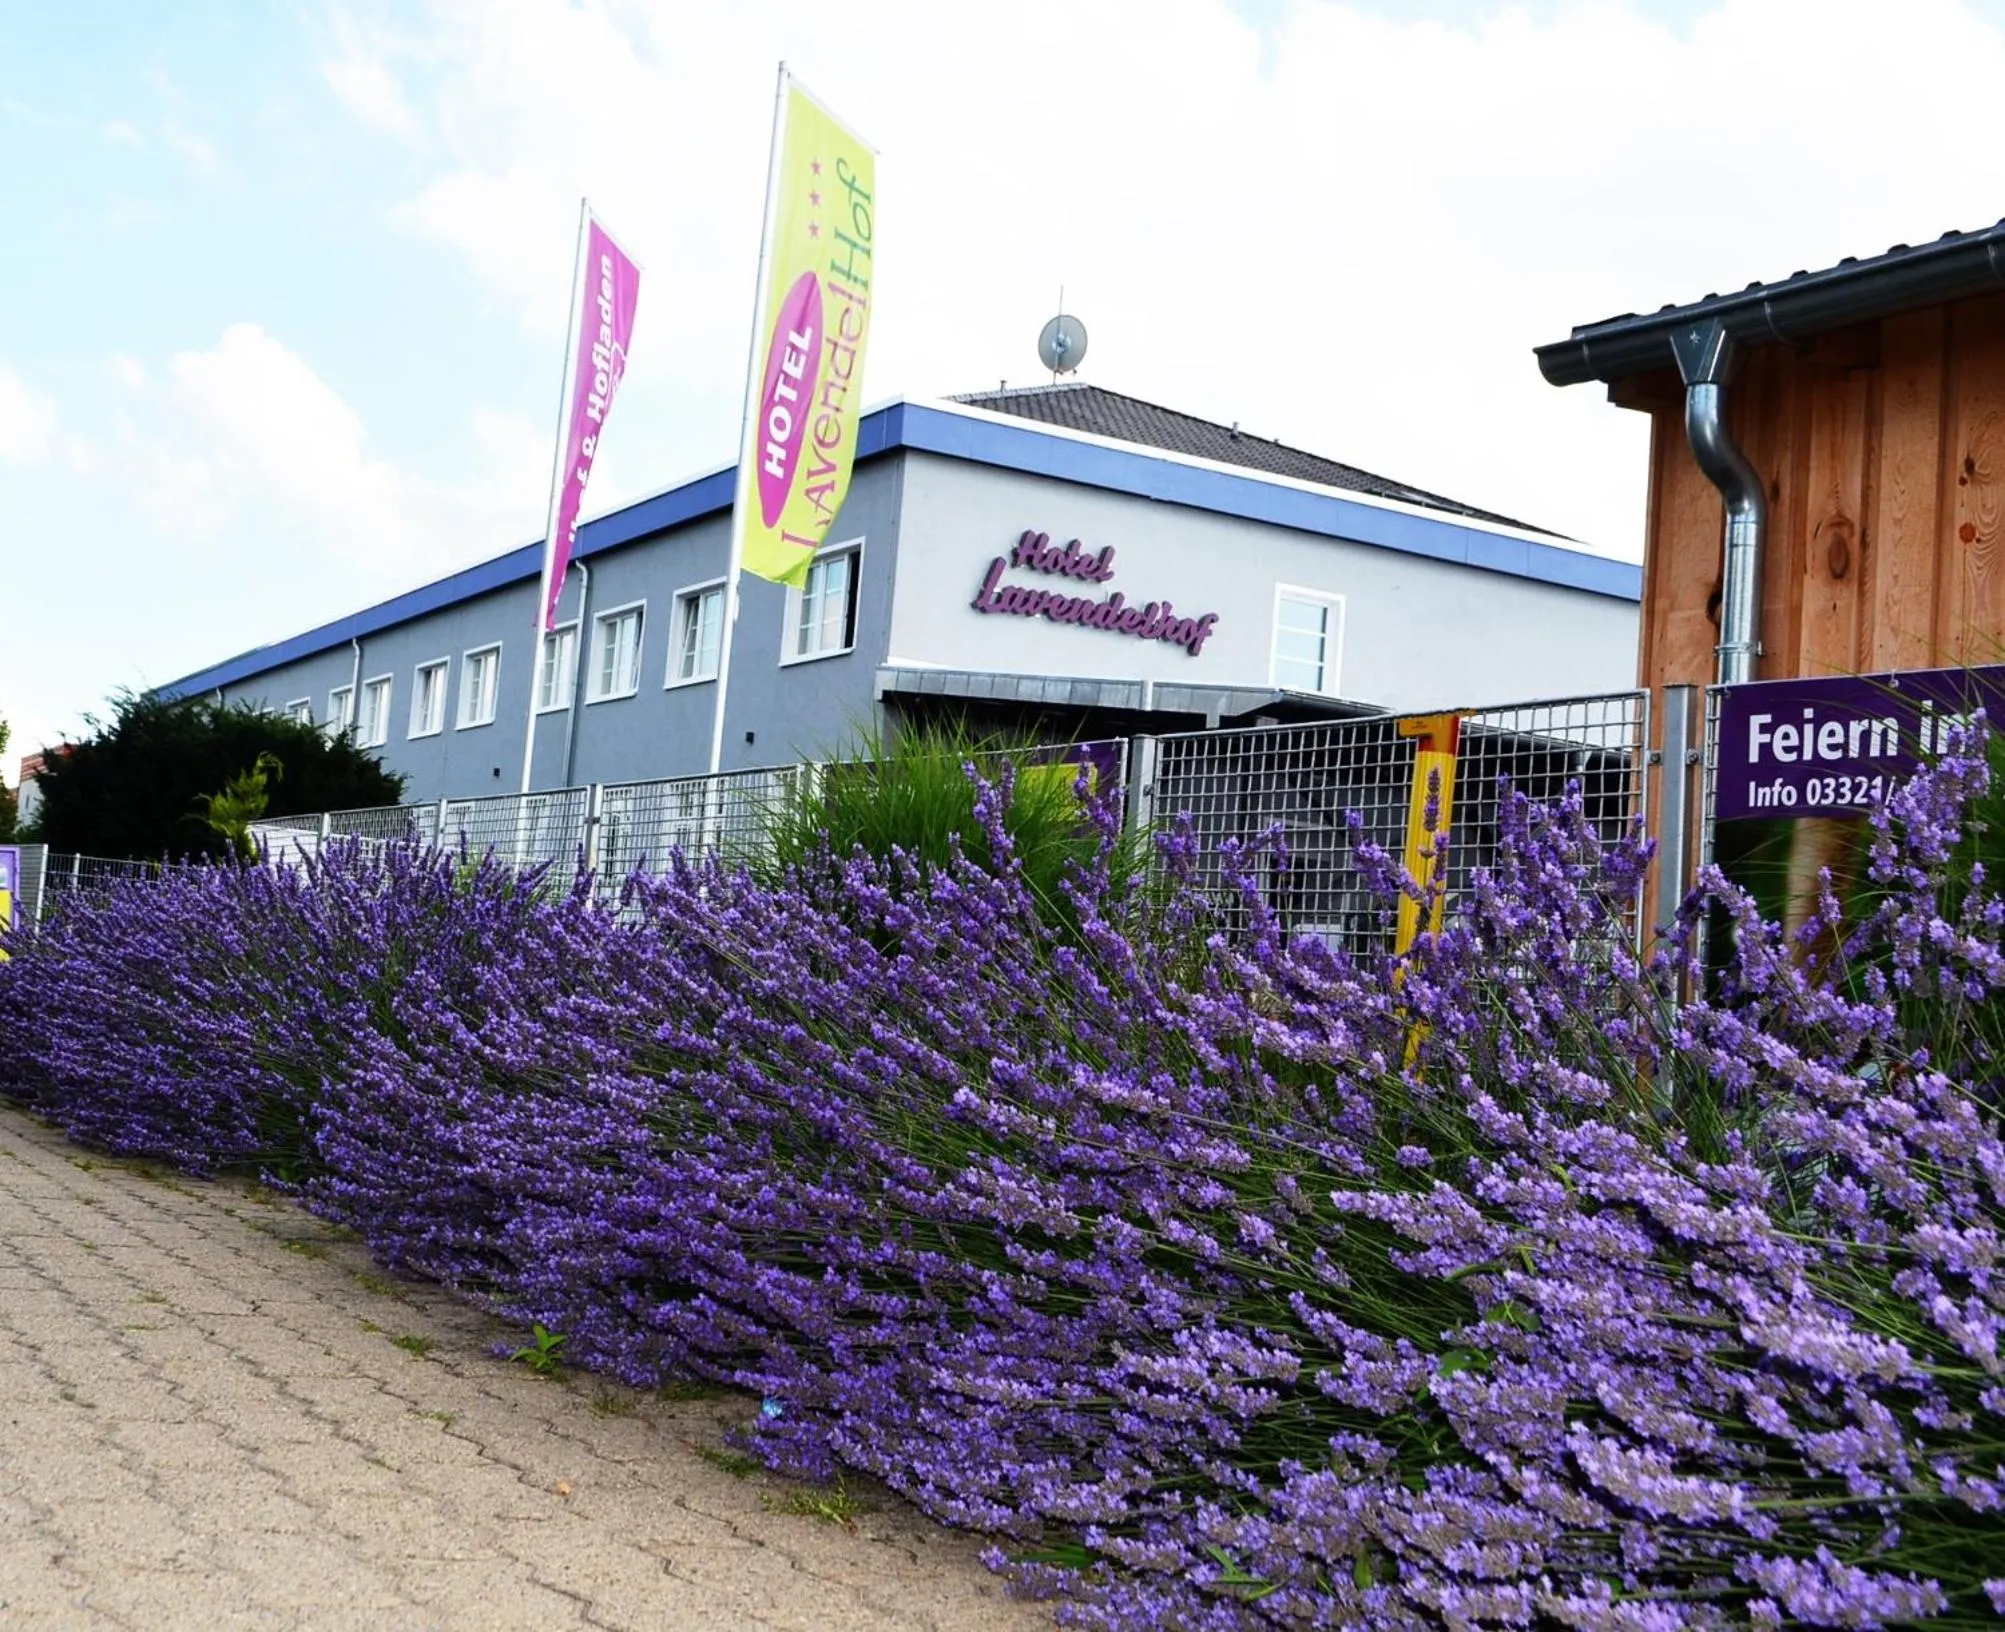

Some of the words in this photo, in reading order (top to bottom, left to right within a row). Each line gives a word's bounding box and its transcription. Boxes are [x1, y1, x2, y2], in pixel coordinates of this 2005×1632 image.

[586, 253, 614, 424] Hofladen
[764, 325, 813, 480] HOTEL
[1011, 529, 1116, 583] Hotel
[970, 556, 1220, 657] Lavendelhof
[1748, 708, 1899, 764] Feiern
[1748, 777, 1798, 808] Info
